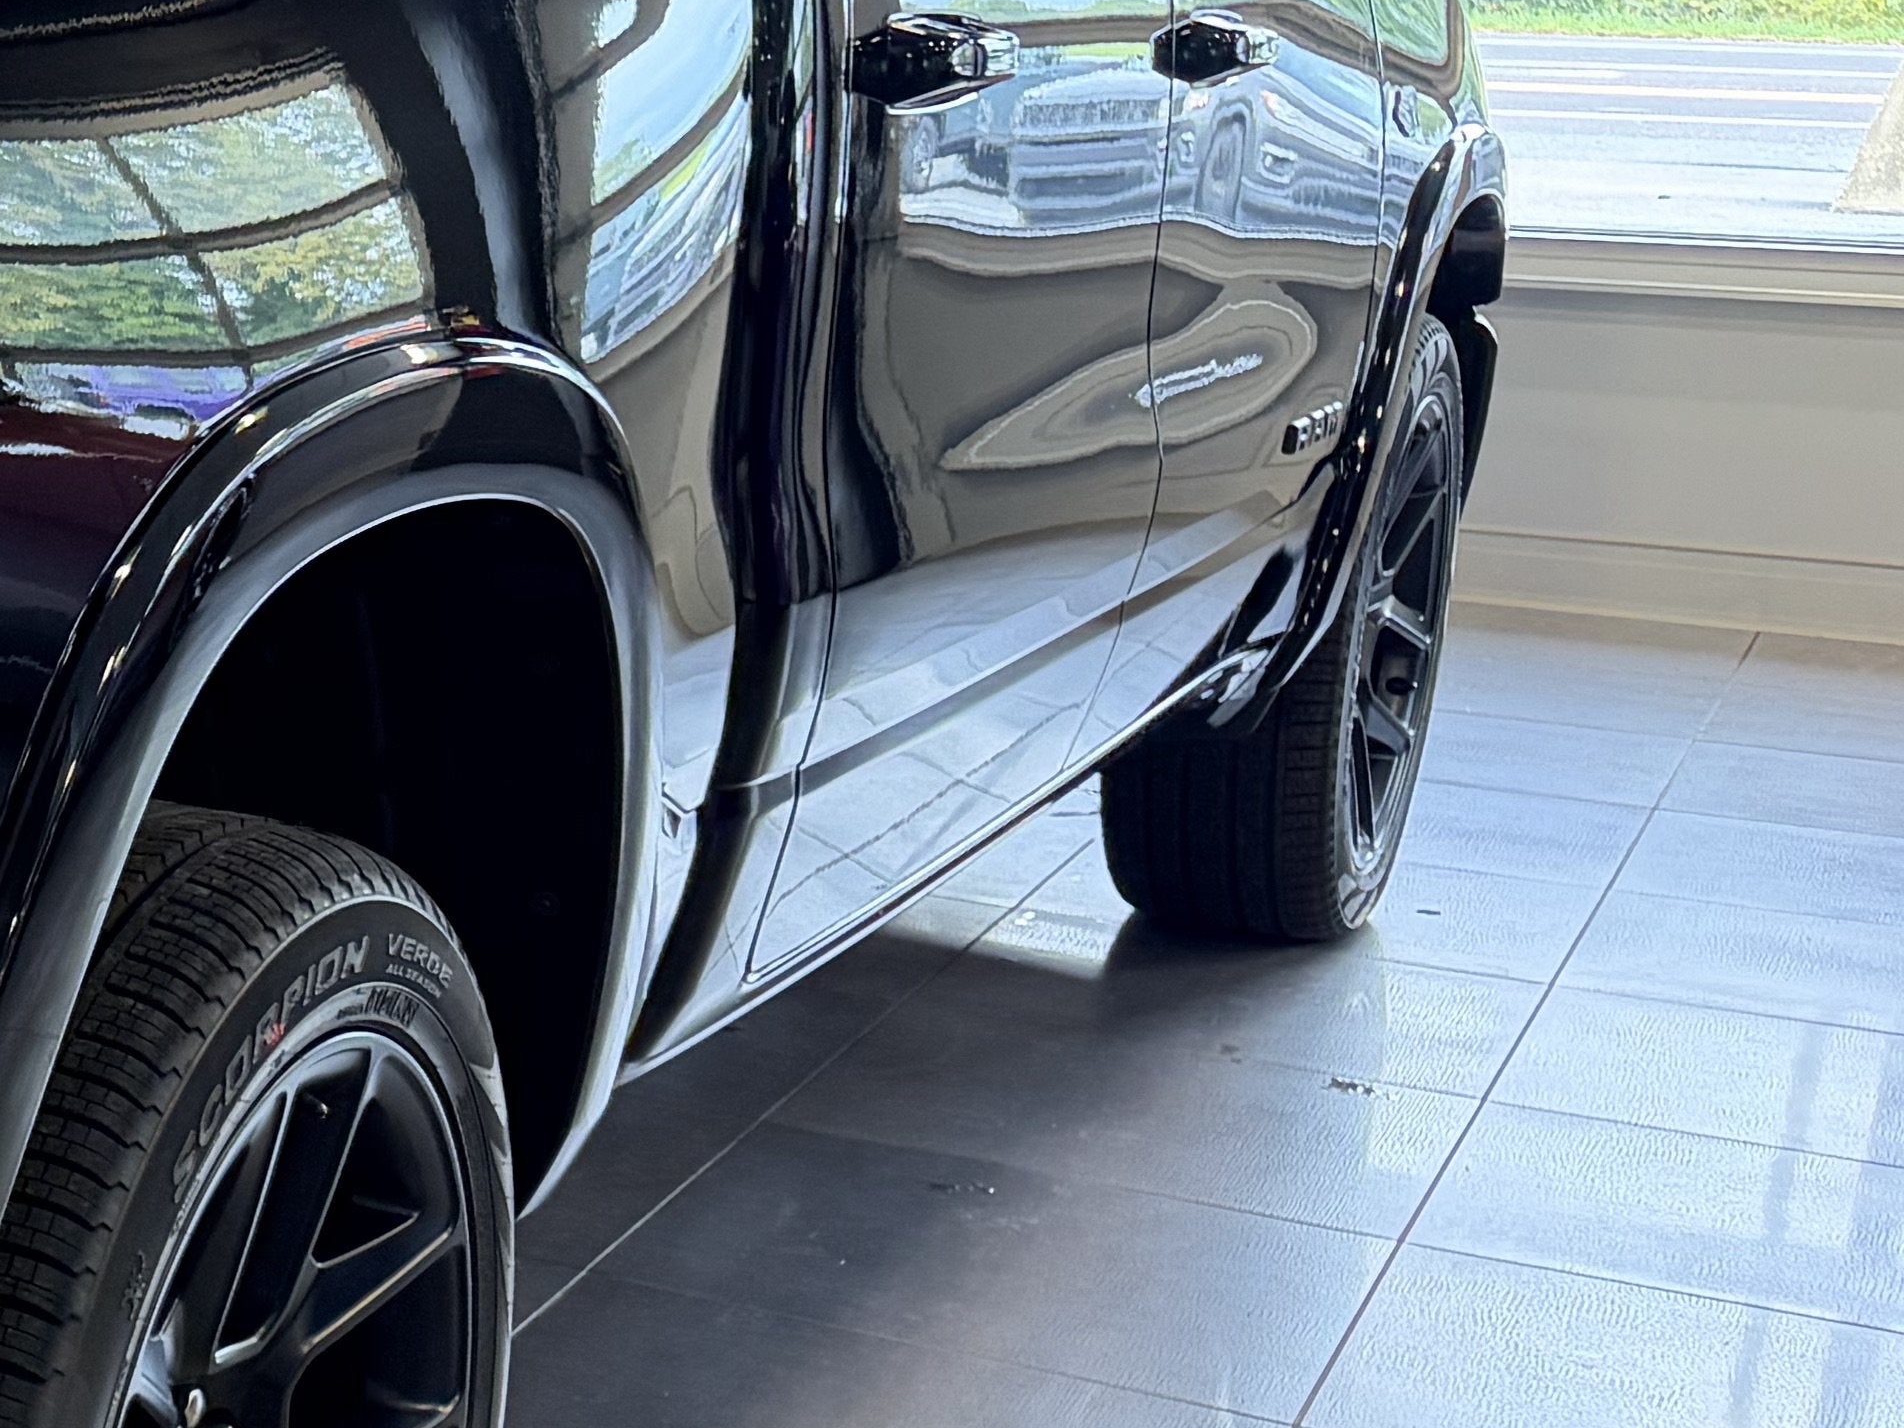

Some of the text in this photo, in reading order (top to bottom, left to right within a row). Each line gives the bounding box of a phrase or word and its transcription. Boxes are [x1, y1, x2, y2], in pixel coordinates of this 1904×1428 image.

[385, 963, 404, 977] ALL
[173, 932, 454, 1205] SCORPION VERDE
